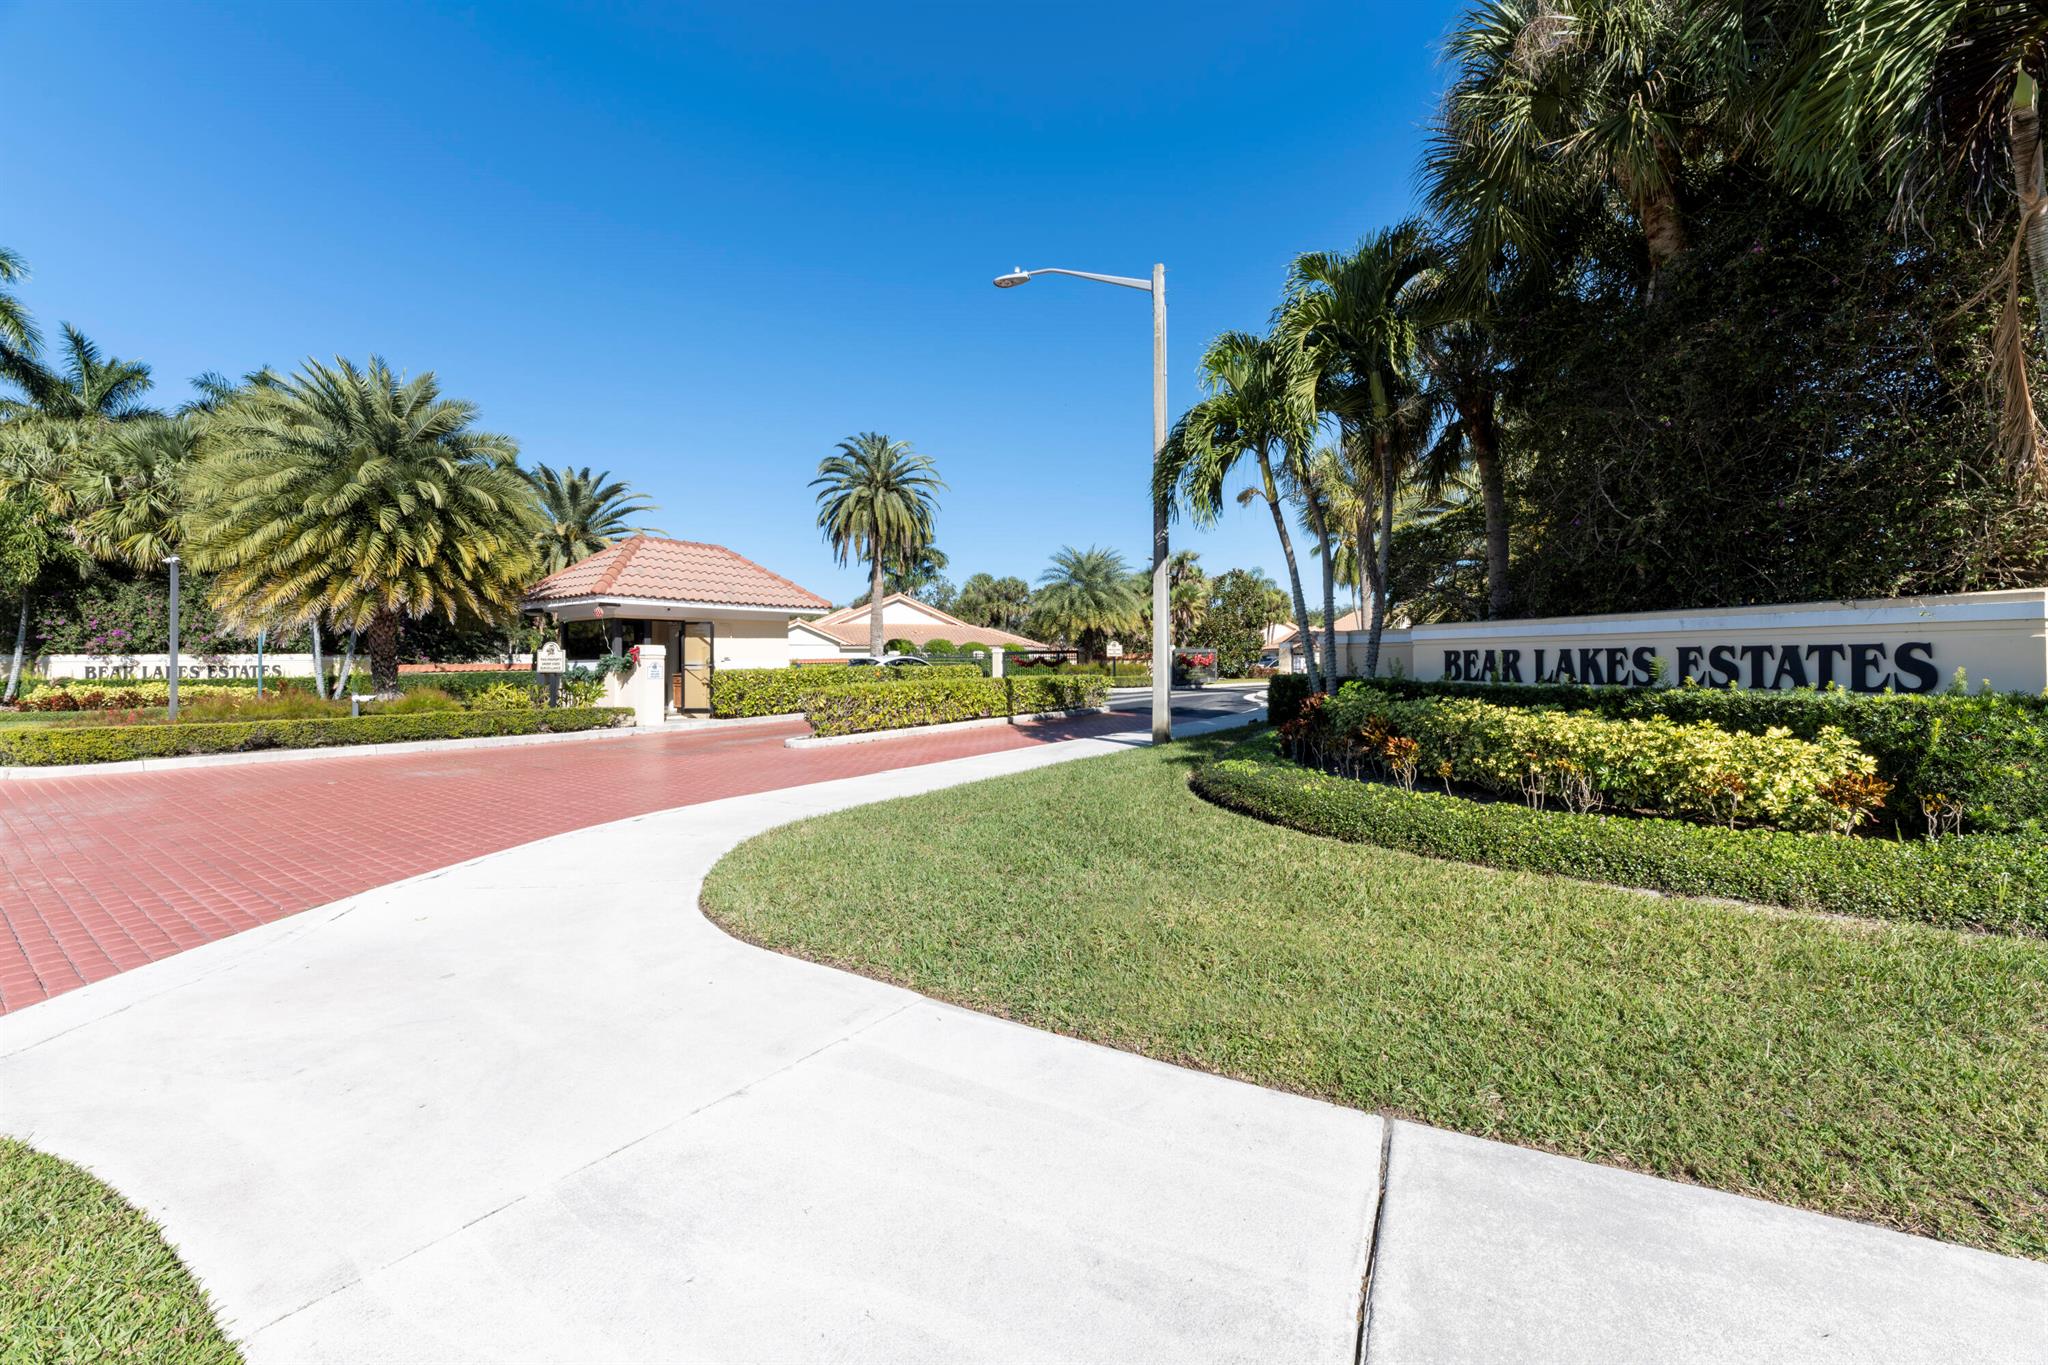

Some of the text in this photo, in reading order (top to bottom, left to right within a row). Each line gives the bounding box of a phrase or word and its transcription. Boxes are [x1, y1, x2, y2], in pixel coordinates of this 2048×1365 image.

[207, 664, 282, 680] ESTATES
[1443, 642, 1939, 694] BEAR LAKES ESTATES
